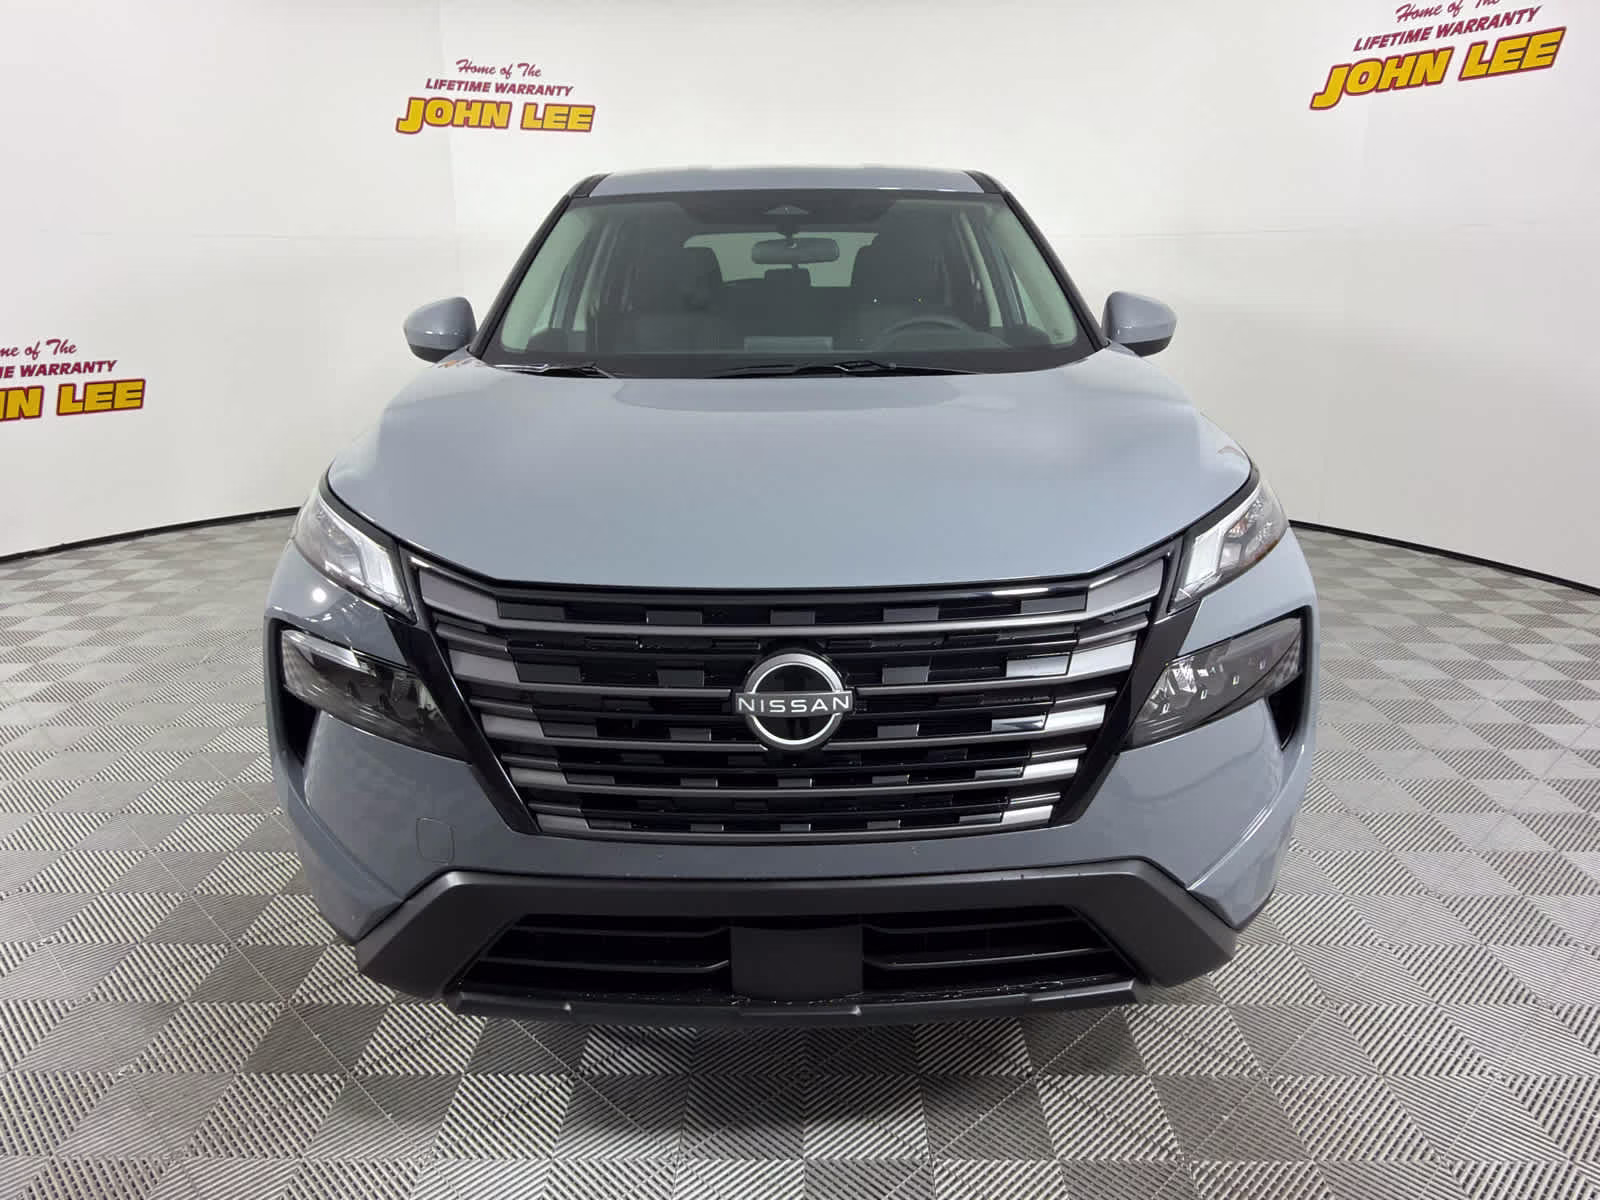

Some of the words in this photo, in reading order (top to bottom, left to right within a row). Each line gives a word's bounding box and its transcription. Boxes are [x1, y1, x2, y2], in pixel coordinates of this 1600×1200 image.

[1395, 3, 1442, 22] Home
[1447, 0, 1463, 17] of
[1353, 26, 1433, 51] LIFETIME
[1435, 5, 1541, 39] WARRANTY
[456, 58, 496, 75] Home
[499, 63, 513, 79] of
[517, 62, 542, 77] The
[1310, 46, 1455, 110] JOHN
[1458, 26, 1567, 81] LEE
[425, 78, 491, 93] LIFETIME
[494, 82, 573, 96] WARRANTY
[395, 97, 512, 134] JOHN
[520, 102, 595, 131] LEE
[24, 341, 41, 360] of
[46, 338, 77, 355] The
[20, 359, 118, 377] WARRANTY
[56, 378, 146, 416] LEE
[738, 696, 849, 713] NISSAN
